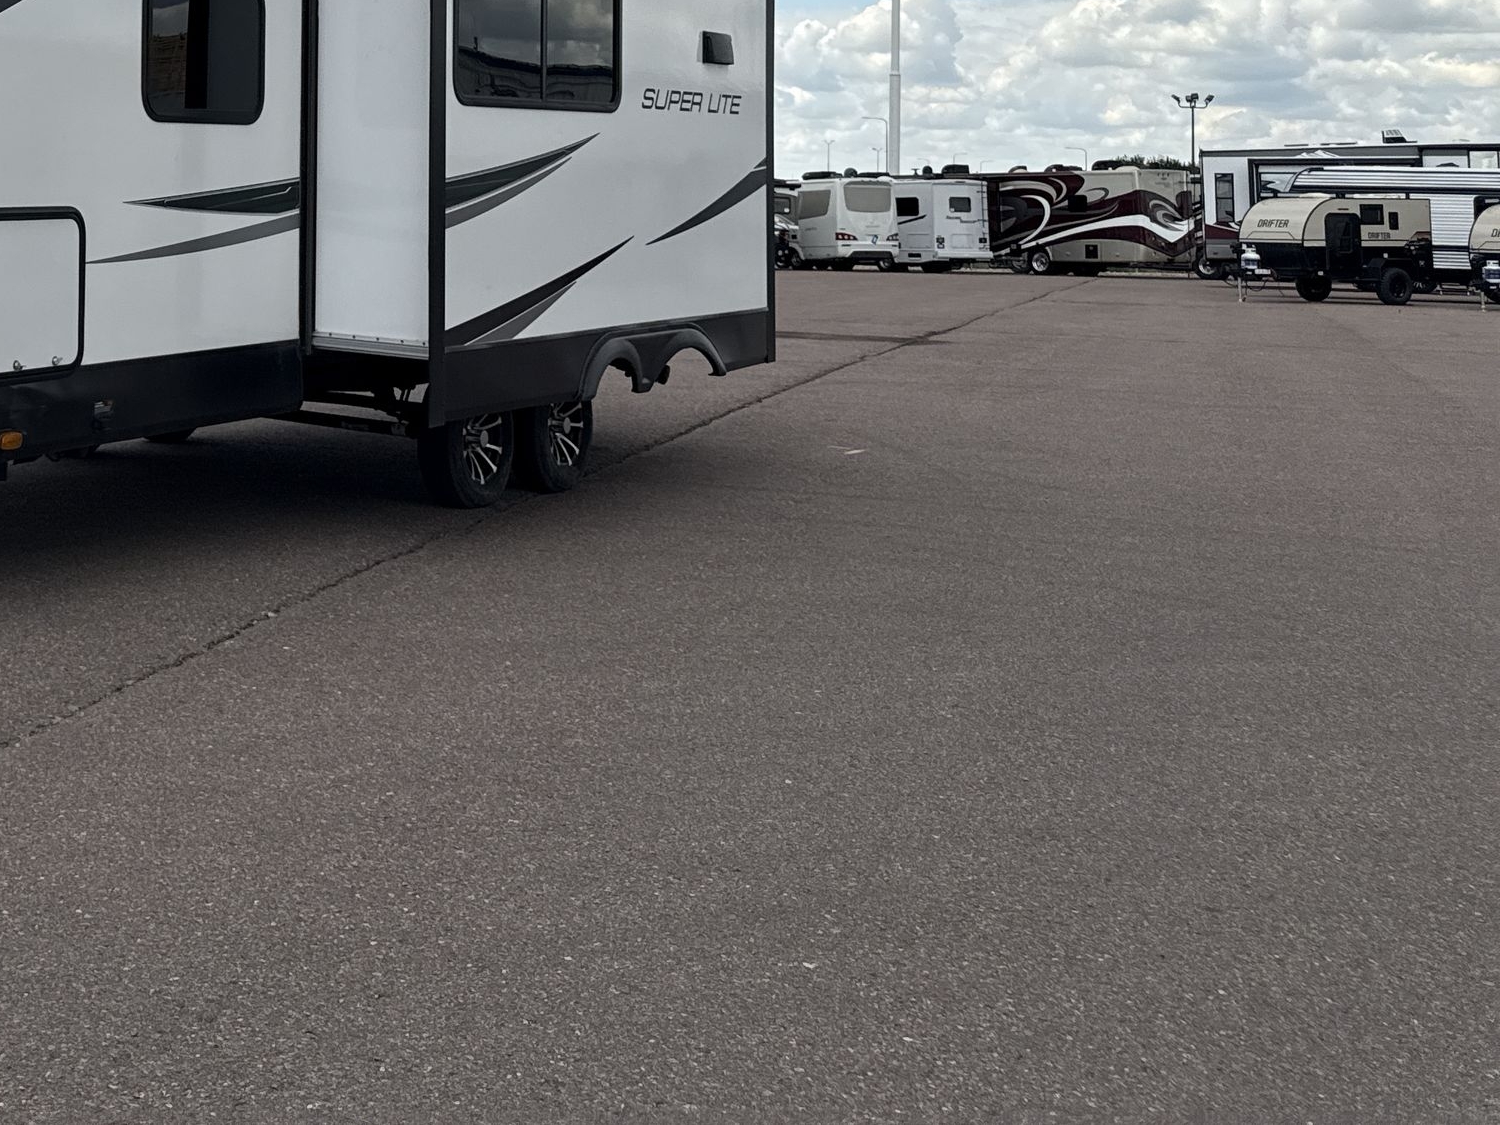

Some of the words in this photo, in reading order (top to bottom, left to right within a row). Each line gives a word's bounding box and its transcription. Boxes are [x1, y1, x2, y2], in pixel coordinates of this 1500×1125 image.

[641, 88, 704, 113] SUPER
[707, 93, 742, 115] LITE
[1257, 218, 1290, 228] DRIFTER
